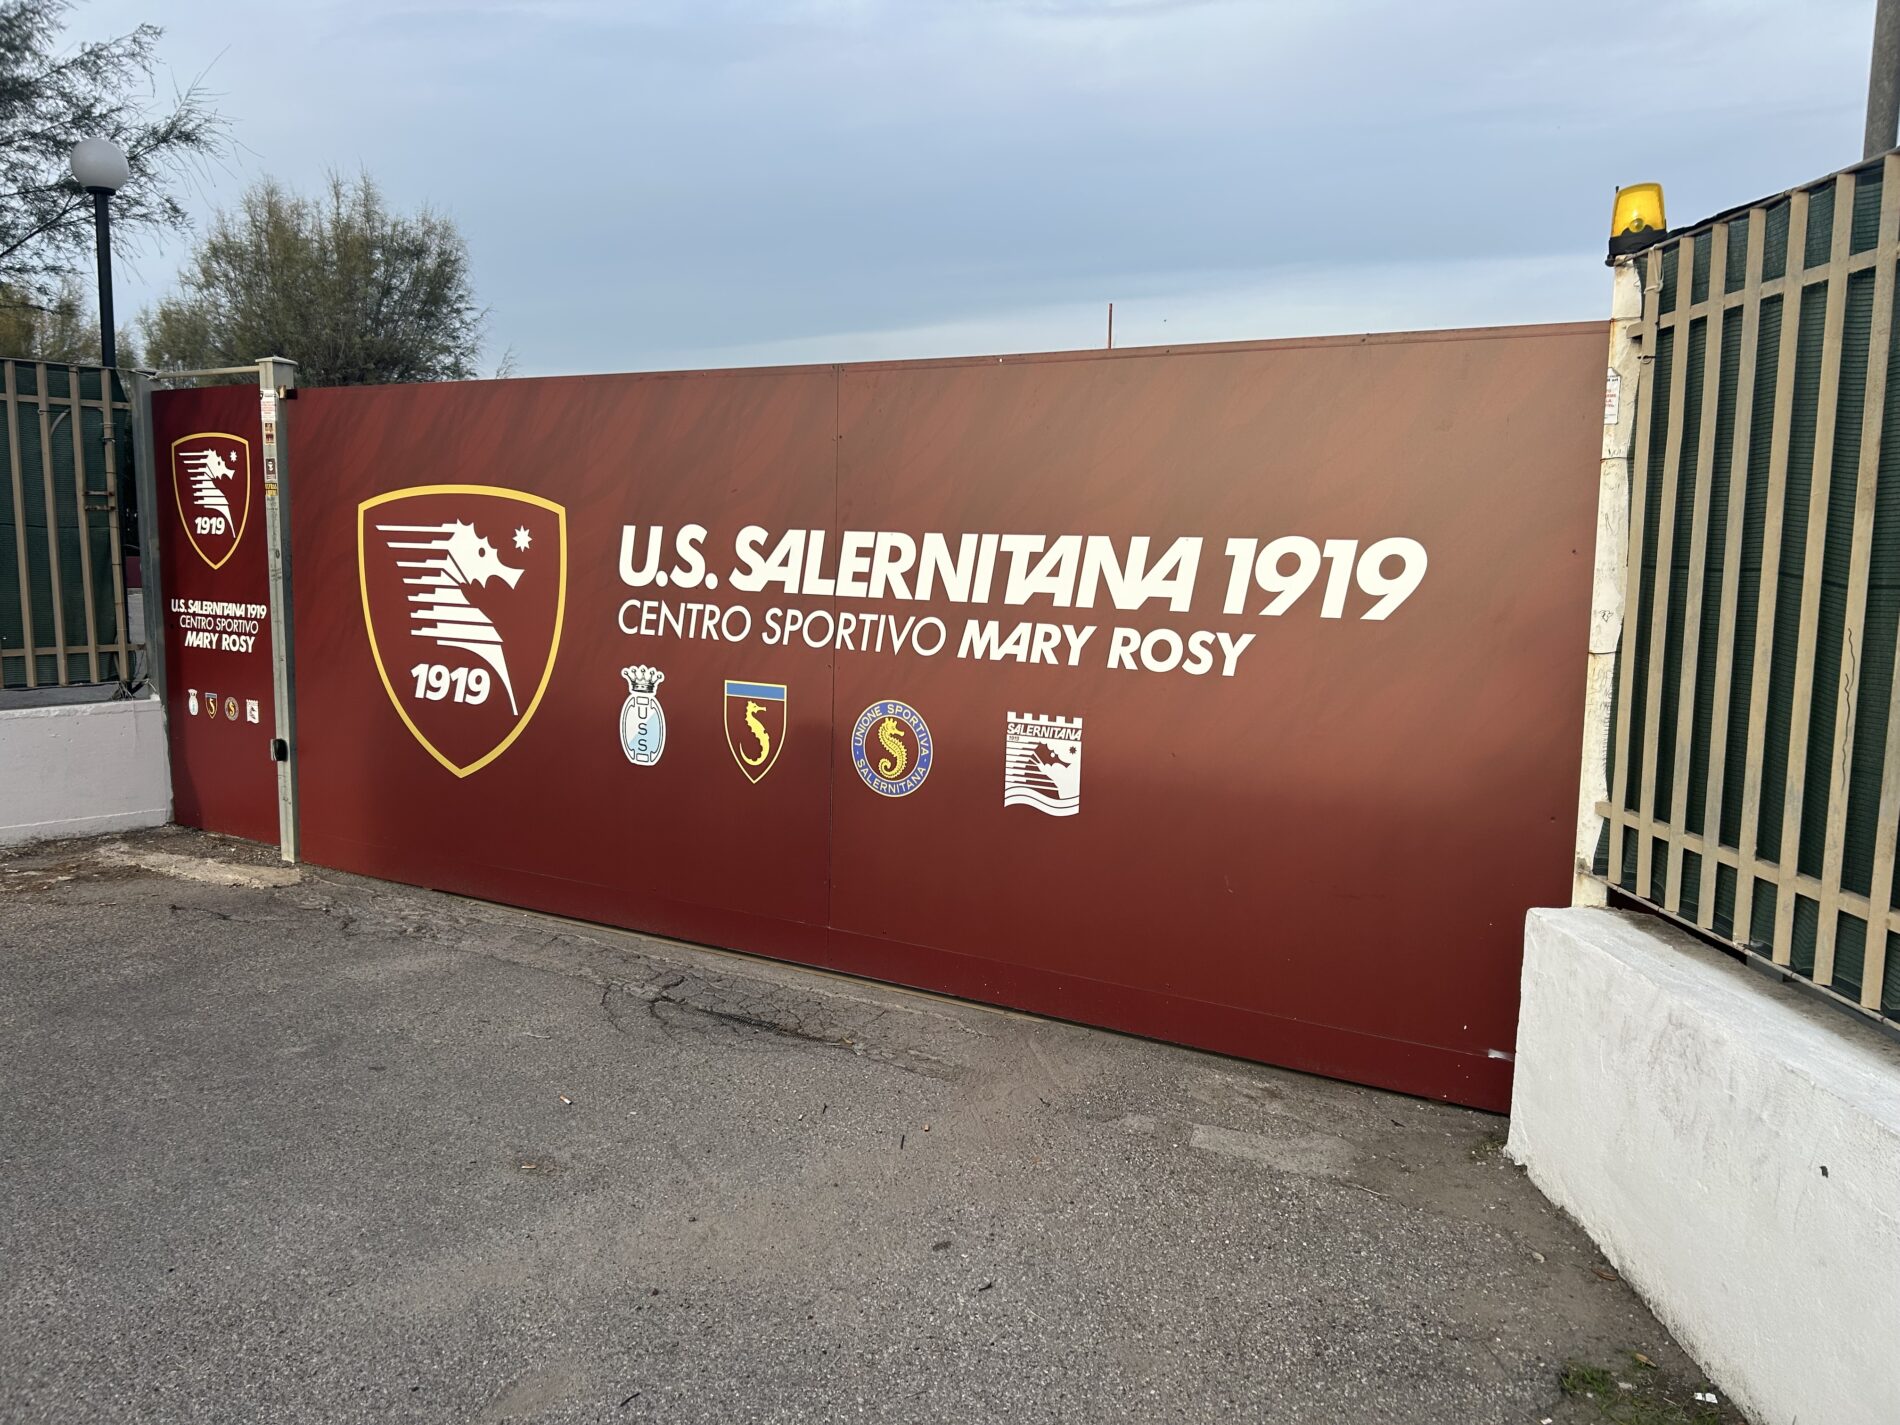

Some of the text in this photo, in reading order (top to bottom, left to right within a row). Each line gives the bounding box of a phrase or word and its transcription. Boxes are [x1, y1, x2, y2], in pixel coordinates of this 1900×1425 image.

[194, 516, 226, 536] 1919
[618, 524, 1430, 621] U.S. SALERNITANA 1919
[171, 598, 268, 619] U.S. SALERNITANA 1919
[179, 614, 259, 635] CENTRO SPORTIVO
[617, 599, 1257, 677] CENTRO SPORTIVO MARY ROSY
[184, 630, 256, 654] MARY ROSY
[410, 663, 491, 706] 1919
[854, 703, 930, 756] UNIONE SPORTIVA
[1007, 722, 1083, 741] SALERNITANA
[856, 758, 927, 794] SALERNITANA
